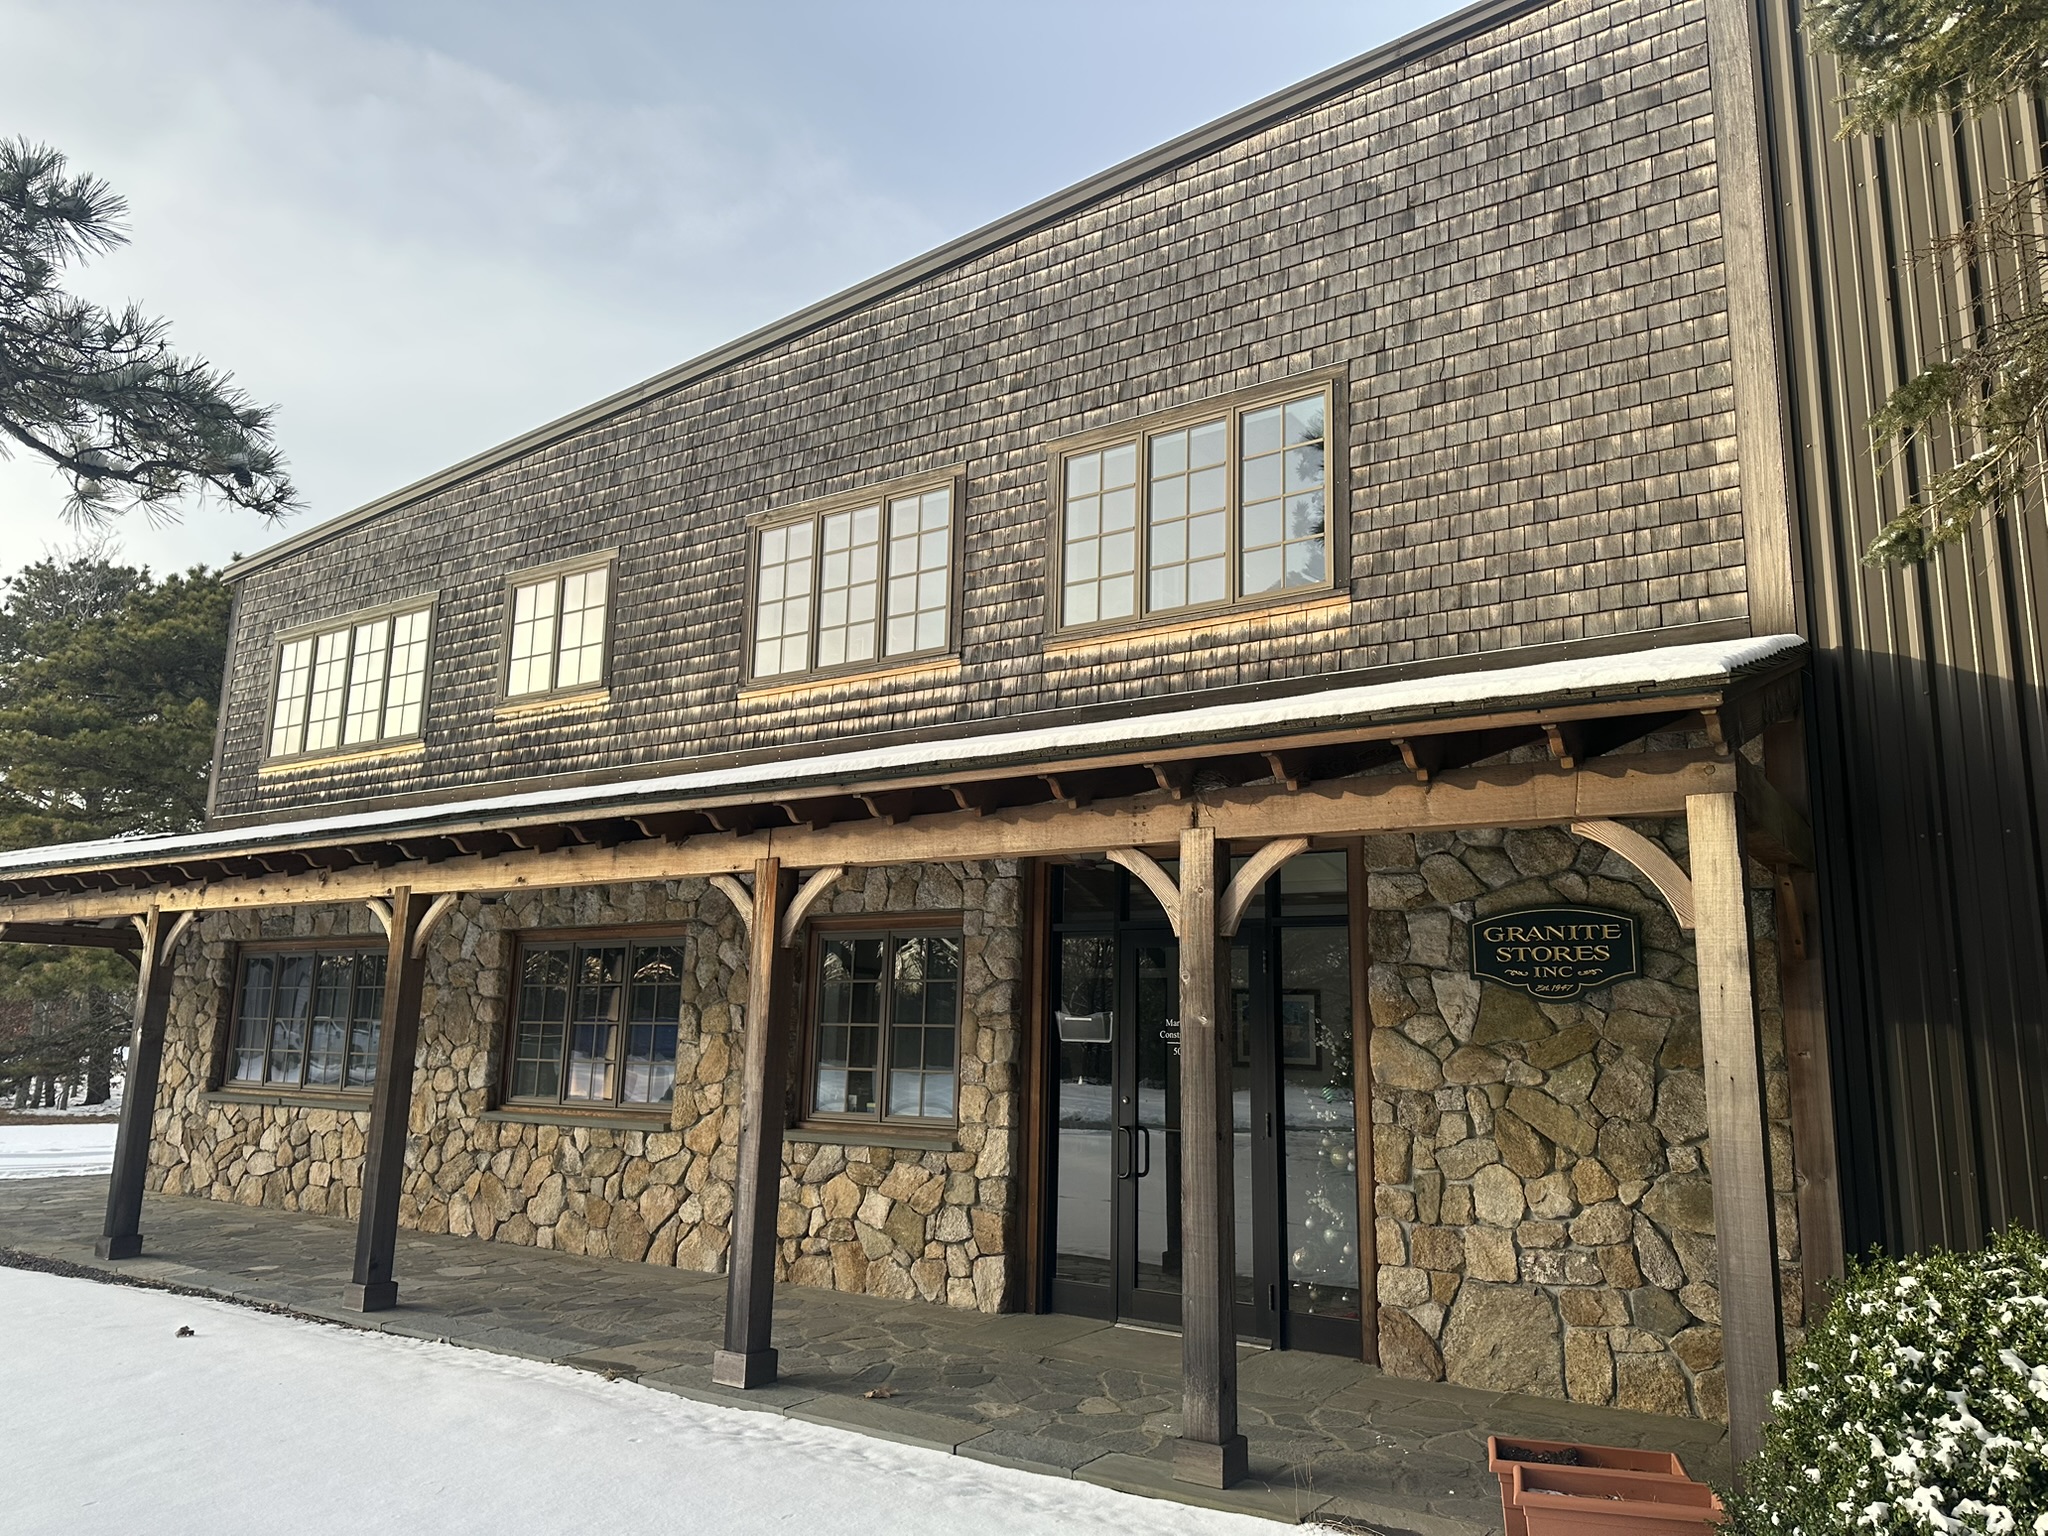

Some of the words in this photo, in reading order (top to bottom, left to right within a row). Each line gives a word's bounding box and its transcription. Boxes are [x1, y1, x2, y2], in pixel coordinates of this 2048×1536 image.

[1483, 924, 1622, 943] GRANITE
[1496, 945, 1611, 963] STORES
[1533, 966, 1574, 978] INC
[1550, 984, 1574, 992] 1947
[1159, 1030, 1181, 1038] Const
[1173, 1047, 1181, 1055] 50
